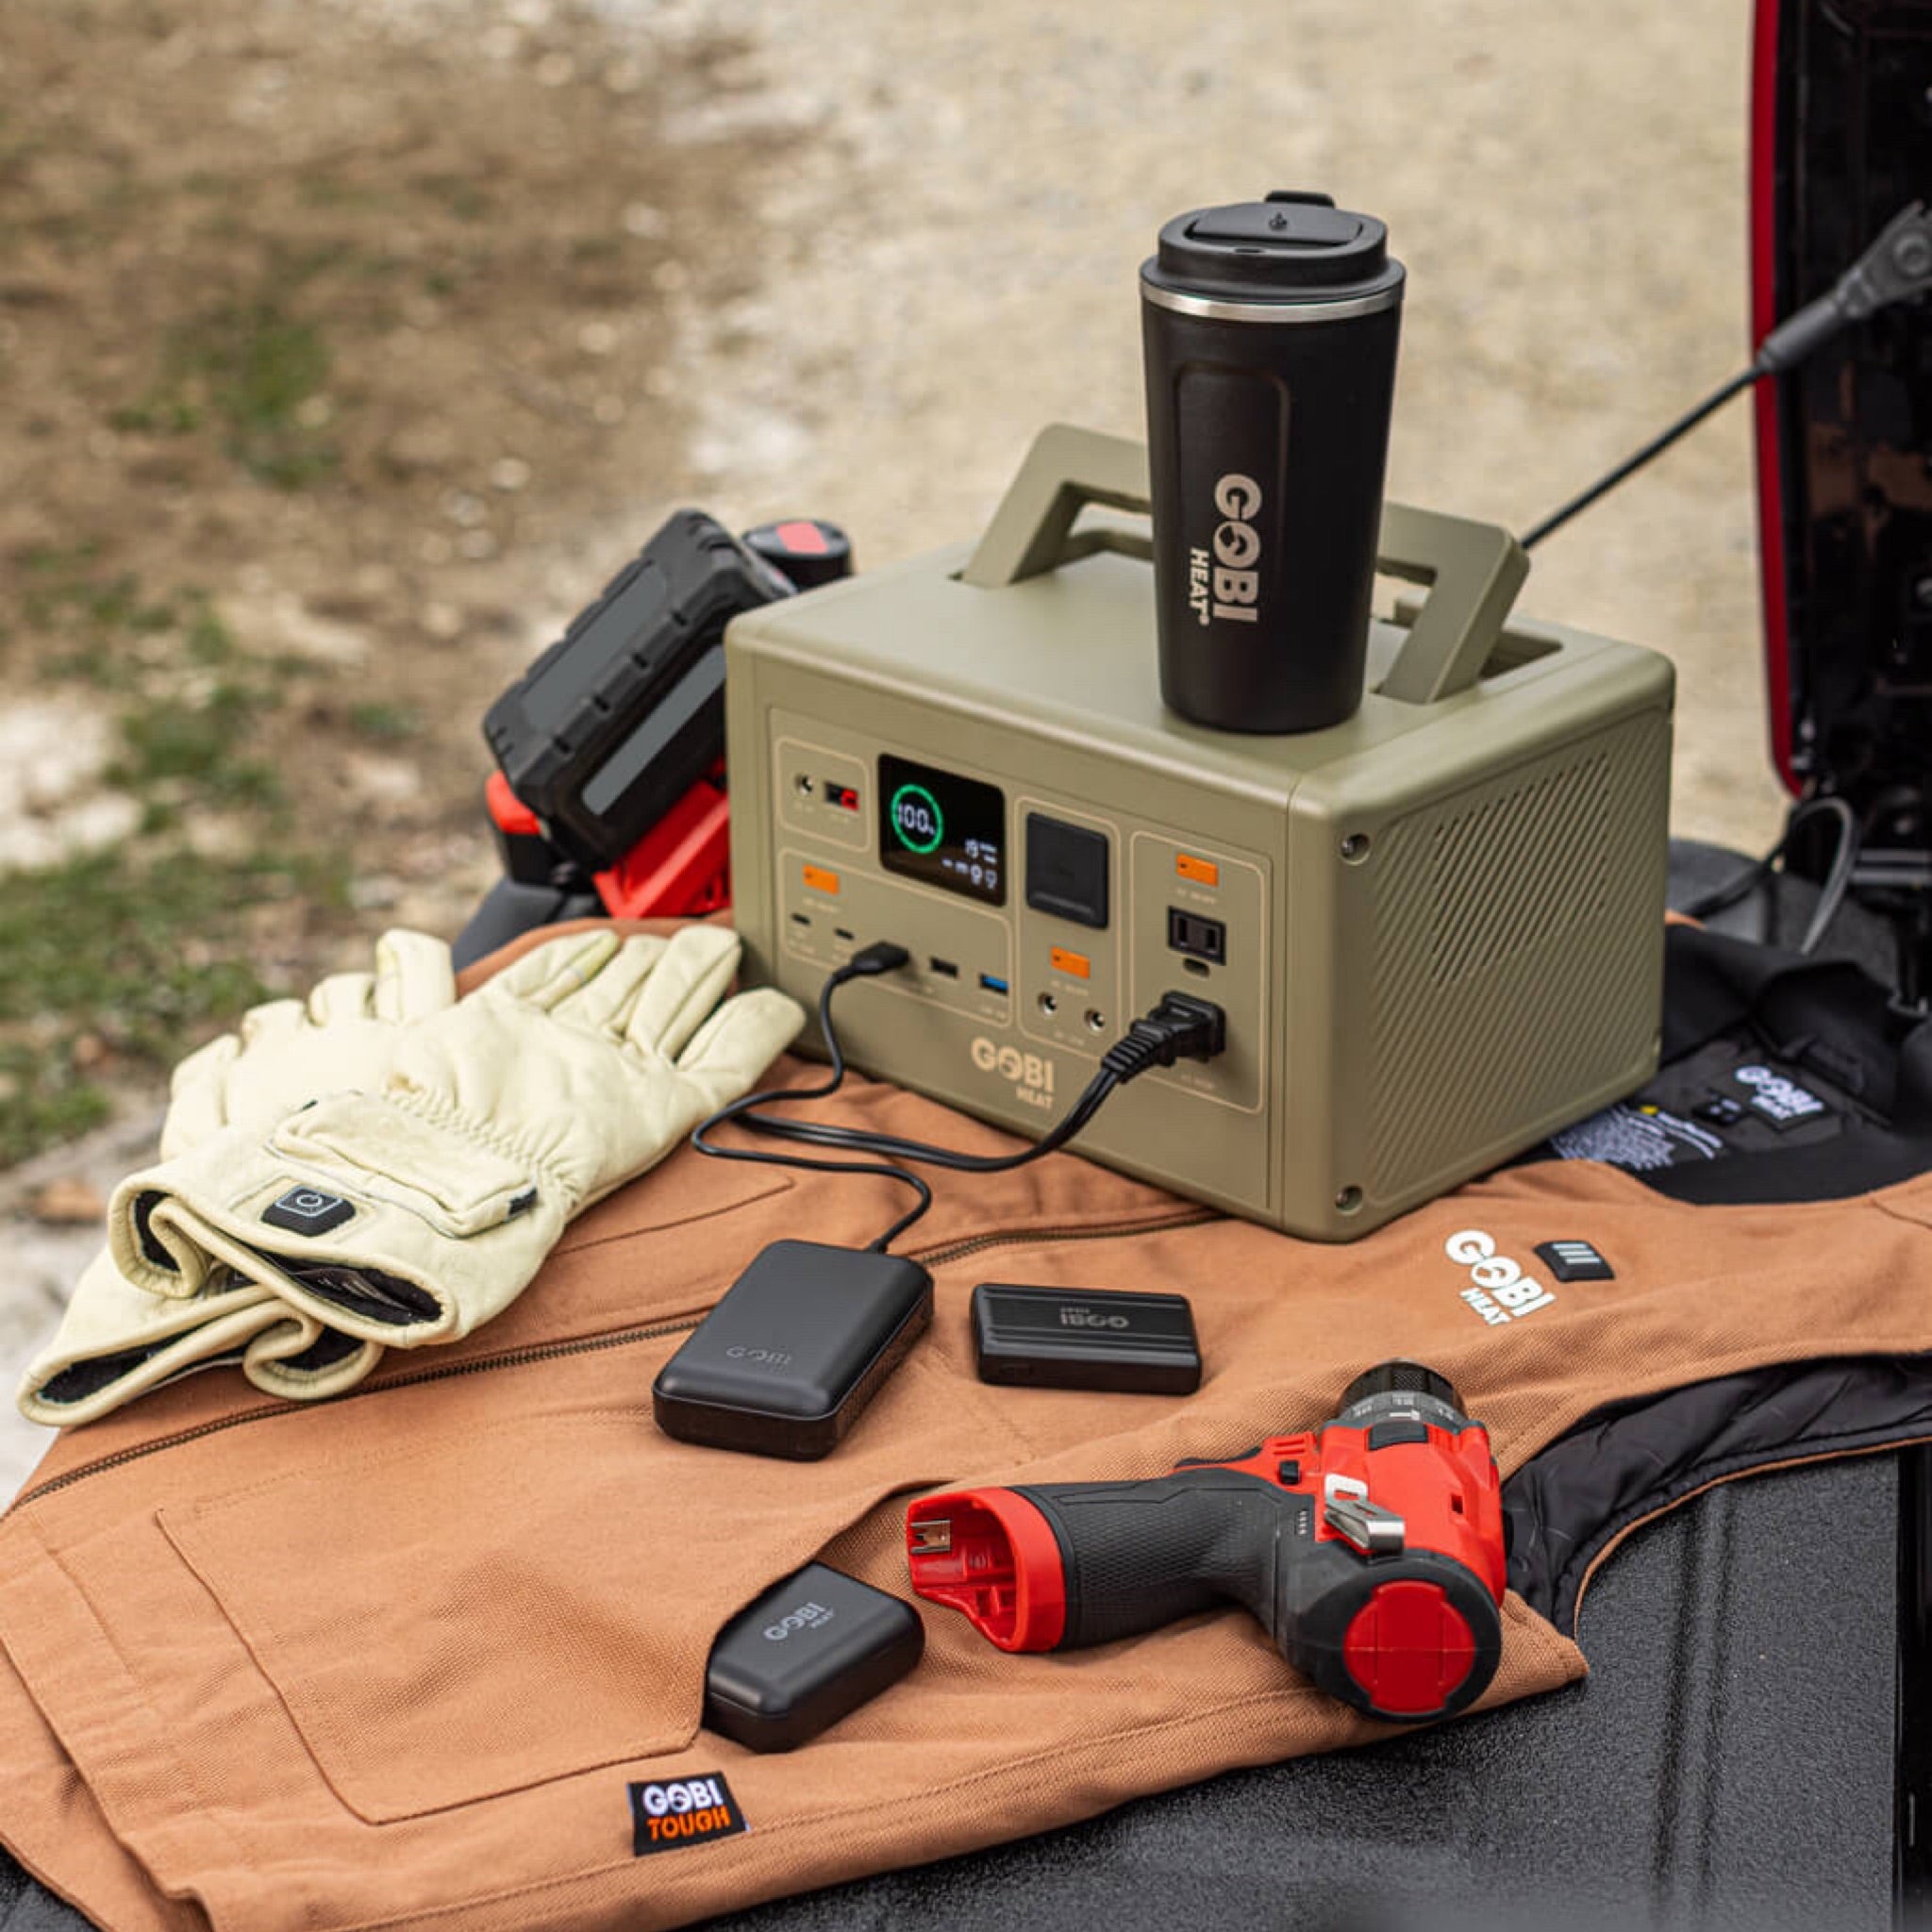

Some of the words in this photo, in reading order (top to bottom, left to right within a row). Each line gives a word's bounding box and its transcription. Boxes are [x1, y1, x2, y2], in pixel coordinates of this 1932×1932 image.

[1214, 474, 1263, 622] GOBI
[1190, 547, 1210, 623] HEAT
[971, 1038, 1054, 1092] GOBI
[1445, 1229, 1556, 1318] GOBI
[762, 1601, 826, 1641] GOBI
[643, 1779, 724, 1816] GOBI
[647, 1805, 731, 1840] TOUGH
